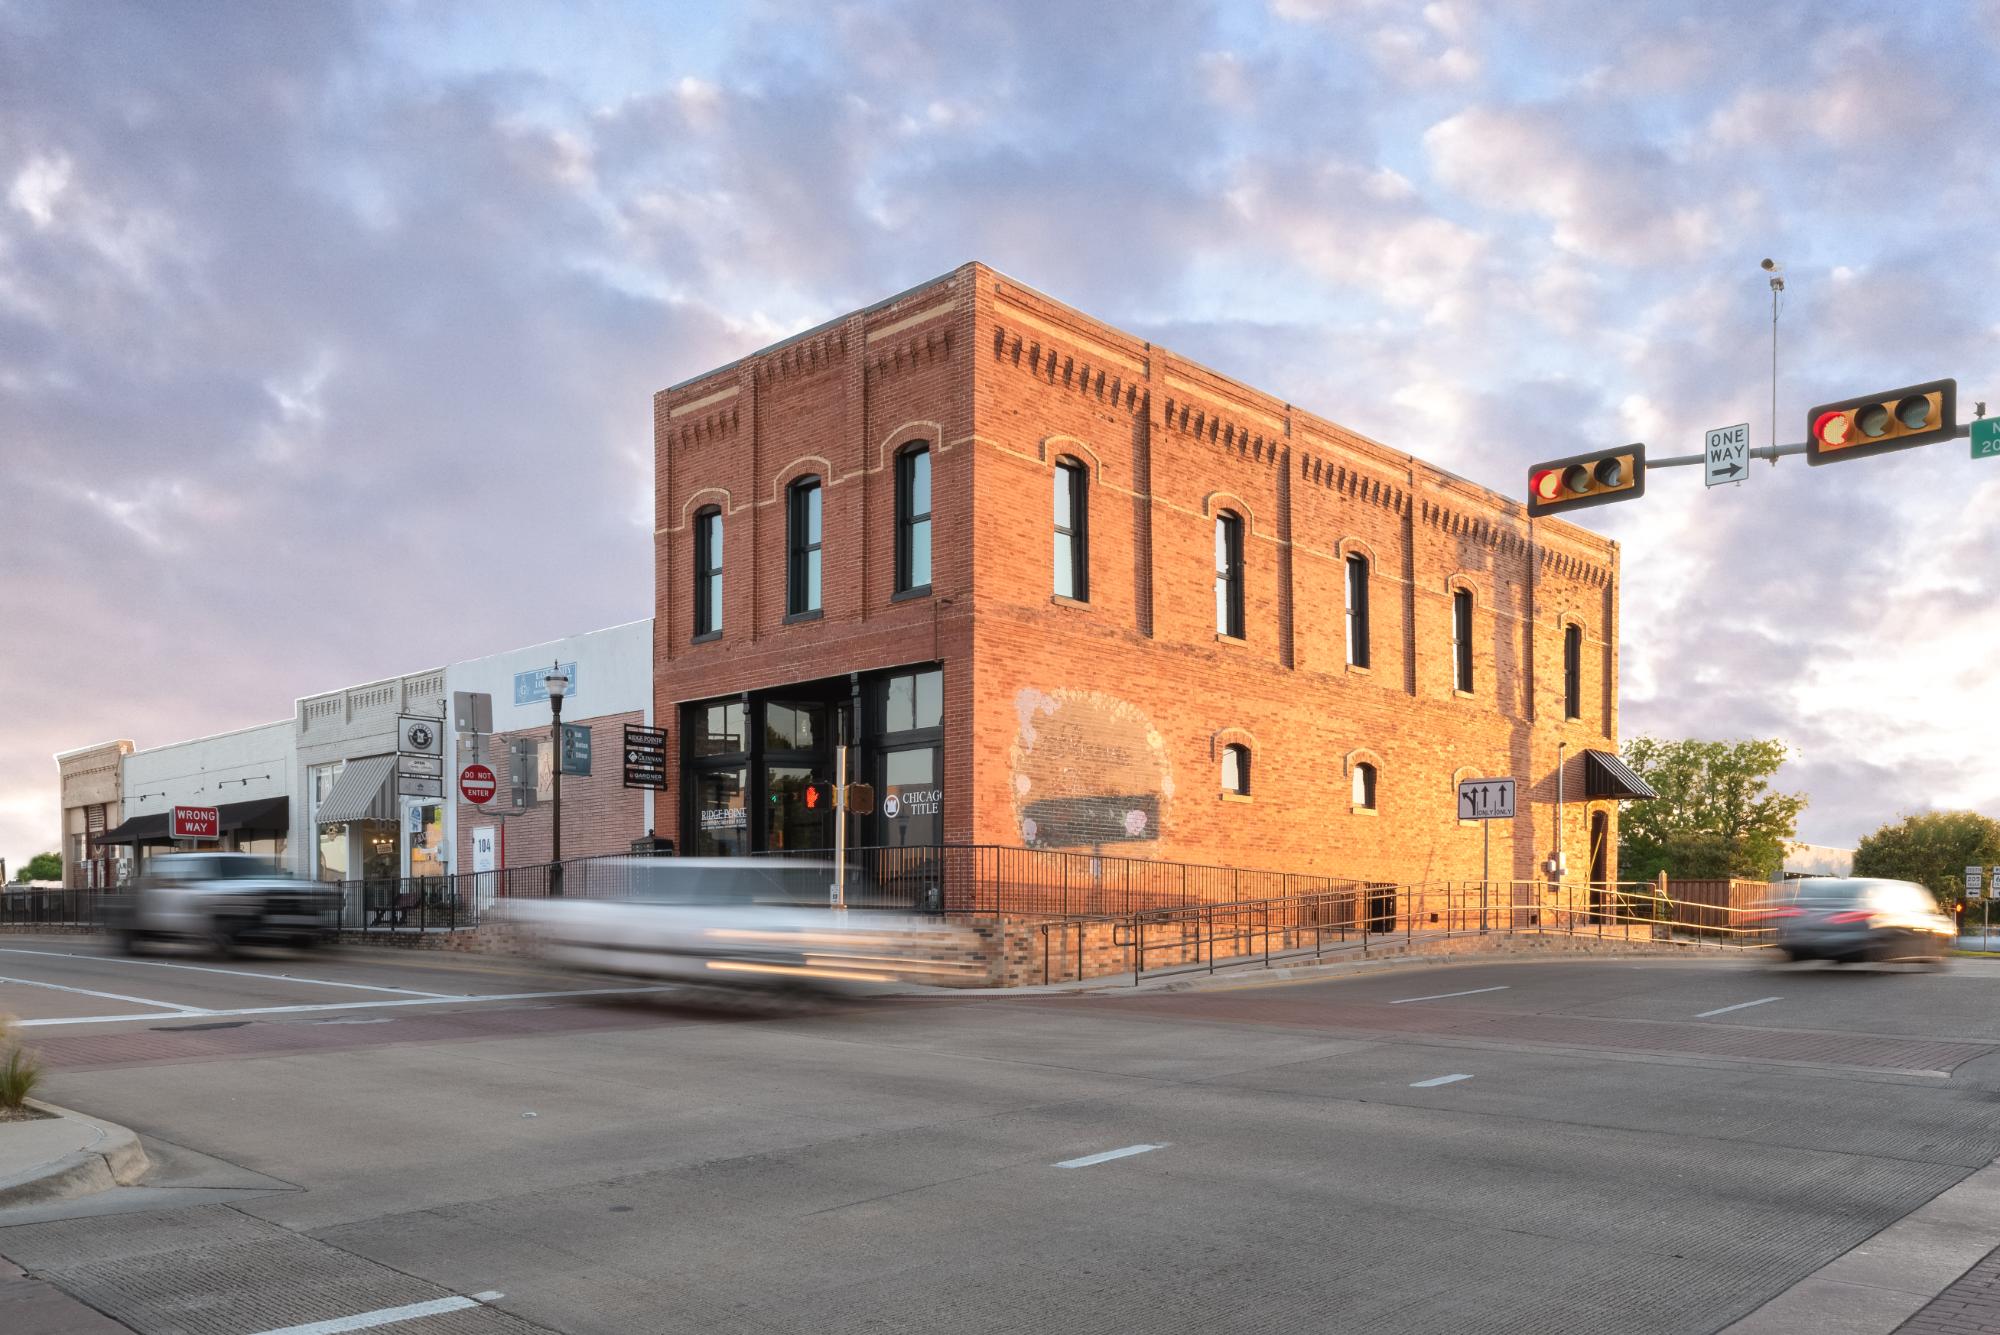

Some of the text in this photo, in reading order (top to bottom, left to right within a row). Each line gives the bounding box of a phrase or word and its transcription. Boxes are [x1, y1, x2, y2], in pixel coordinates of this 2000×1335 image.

[1711, 429, 1744, 447] ONE
[1711, 444, 1744, 463] WAY
[628, 734, 643, 742] RIDGE
[643, 735, 663, 744] POINTE
[464, 771, 492, 780] DO NOT
[468, 789, 489, 797] ENTER
[902, 790, 942, 804] CHICAG
[701, 809, 723, 821] RIDGE
[911, 803, 939, 815] TITLE
[177, 810, 216, 821] WRONG
[185, 822, 208, 833] WAY
[478, 838, 491, 853] 104
